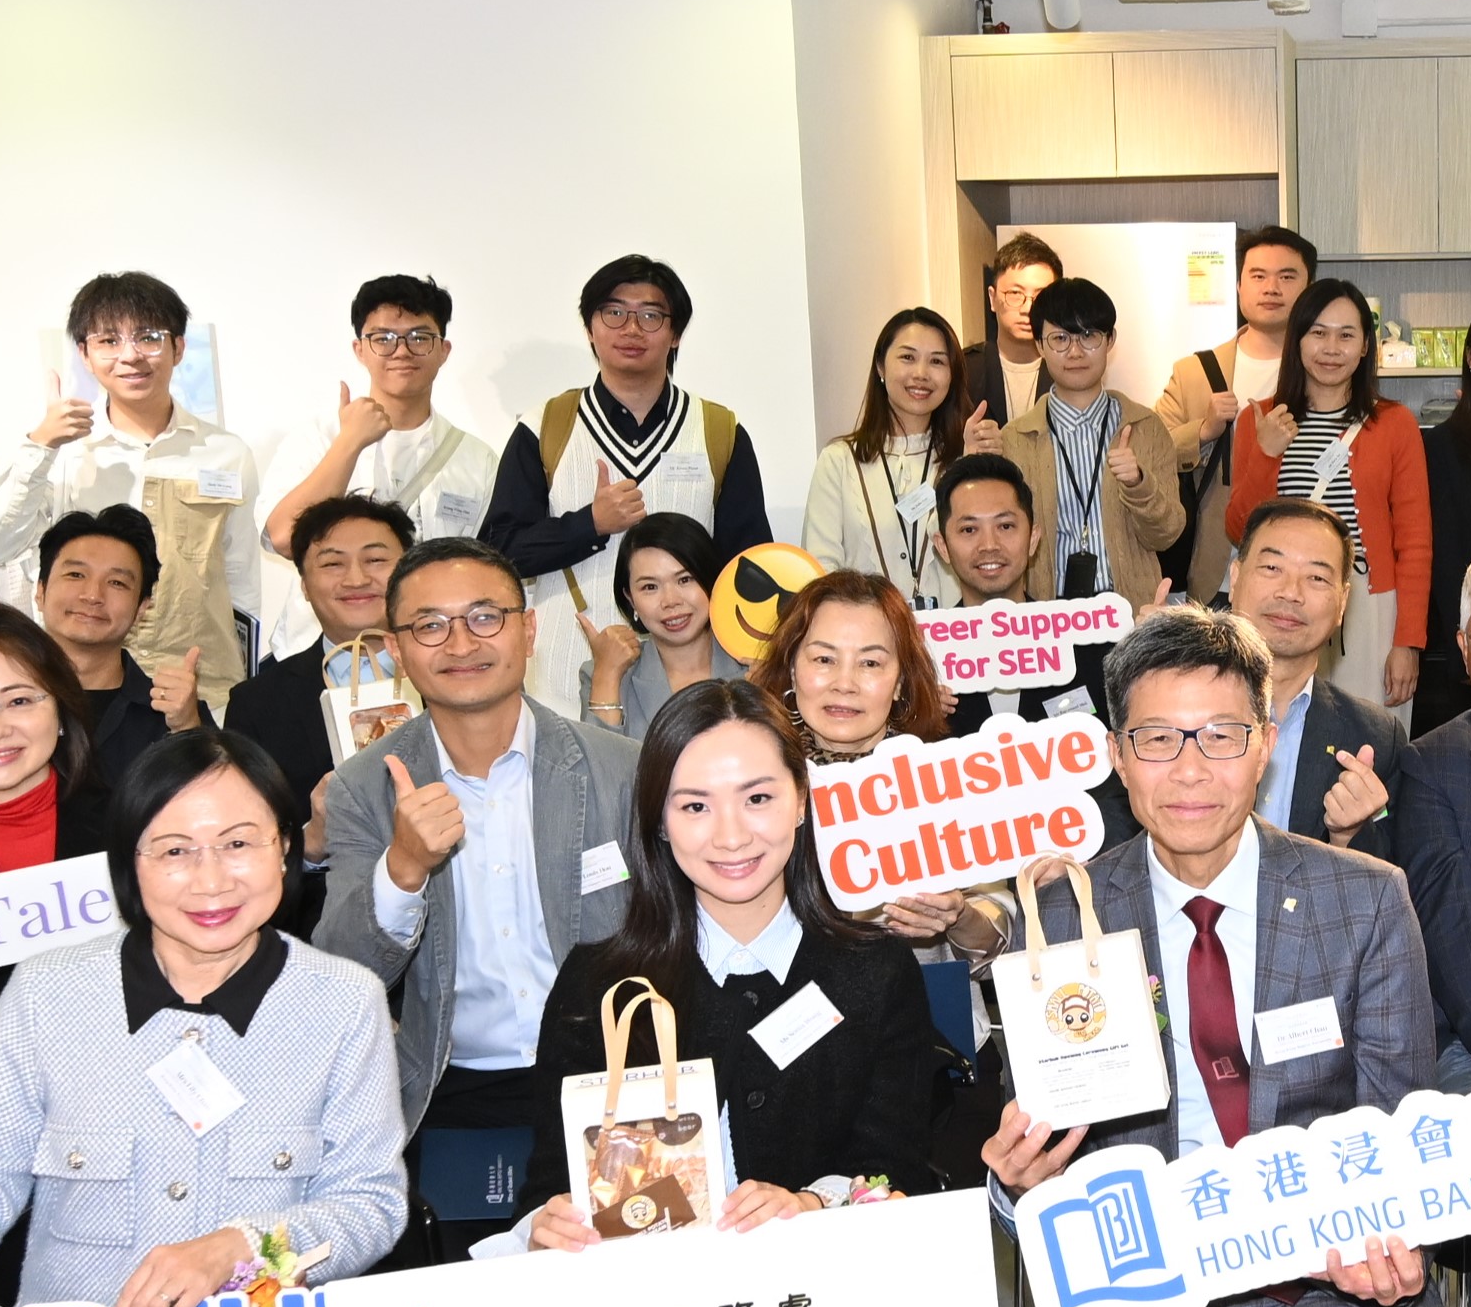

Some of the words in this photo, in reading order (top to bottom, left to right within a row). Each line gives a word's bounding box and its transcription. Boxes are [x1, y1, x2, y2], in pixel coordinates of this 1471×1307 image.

[919, 614, 983, 642] reer
[991, 604, 1120, 641] Support
[943, 651, 991, 680] for
[999, 645, 1062, 676] SEN
[812, 729, 1097, 828] nclusive
[829, 804, 1087, 895] Culture
[580, 1065, 697, 1087] STRHB
[1195, 1223, 1300, 1277] HONG
[1313, 1196, 1407, 1250] KONG
